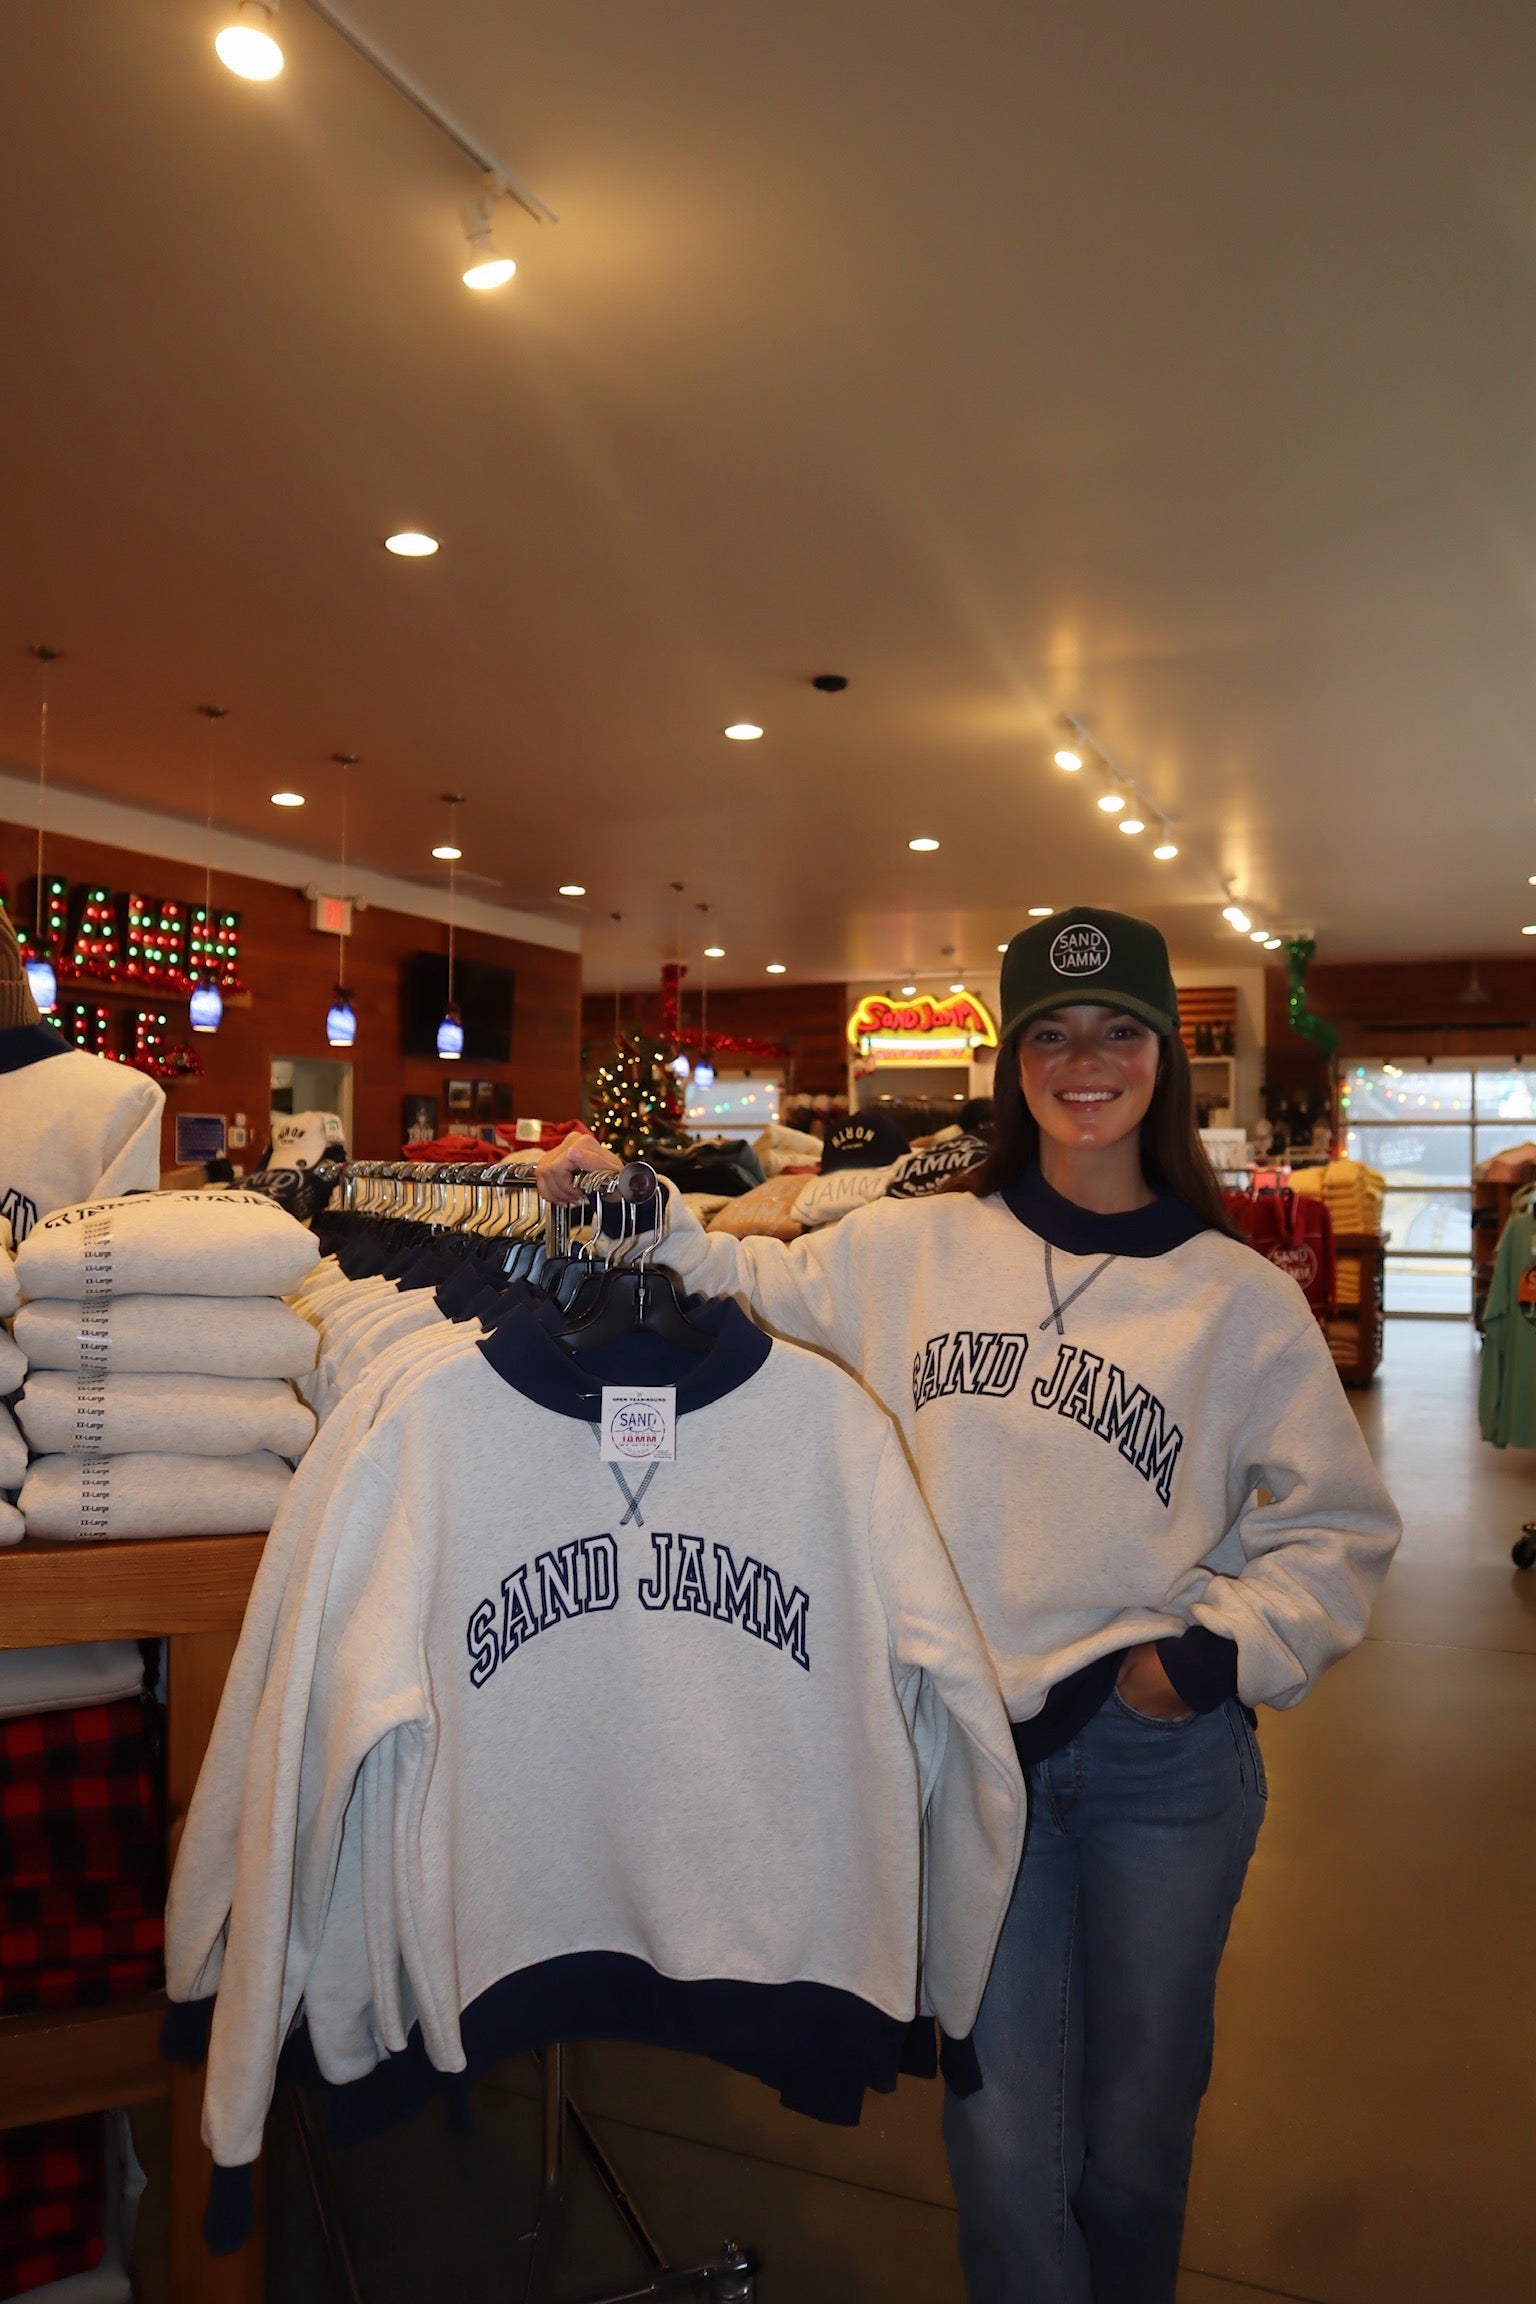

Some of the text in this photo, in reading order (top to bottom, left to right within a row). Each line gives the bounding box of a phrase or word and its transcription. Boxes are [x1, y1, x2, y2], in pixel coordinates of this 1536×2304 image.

[1059, 932, 1102, 949] SAND
[1058, 952, 1102, 969] JAMM
[895, 1149, 976, 1183] JAMM
[804, 1175, 881, 1206] JAMM
[84, 1251, 111, 1259] XX-Large
[81, 1343, 108, 1351] XX-Large
[77, 1408, 105, 1416] XX-Large
[620, 1413, 657, 1427] SAND
[1031, 1343, 1183, 1508] JAMM
[76, 1422, 104, 1430] XX-Large
[82, 1491, 110, 1499] XX-Large
[81, 1505, 109, 1513] XX-Large
[80, 1519, 108, 1527] XX-Large
[466, 1533, 811, 1689] SAND JAMM
